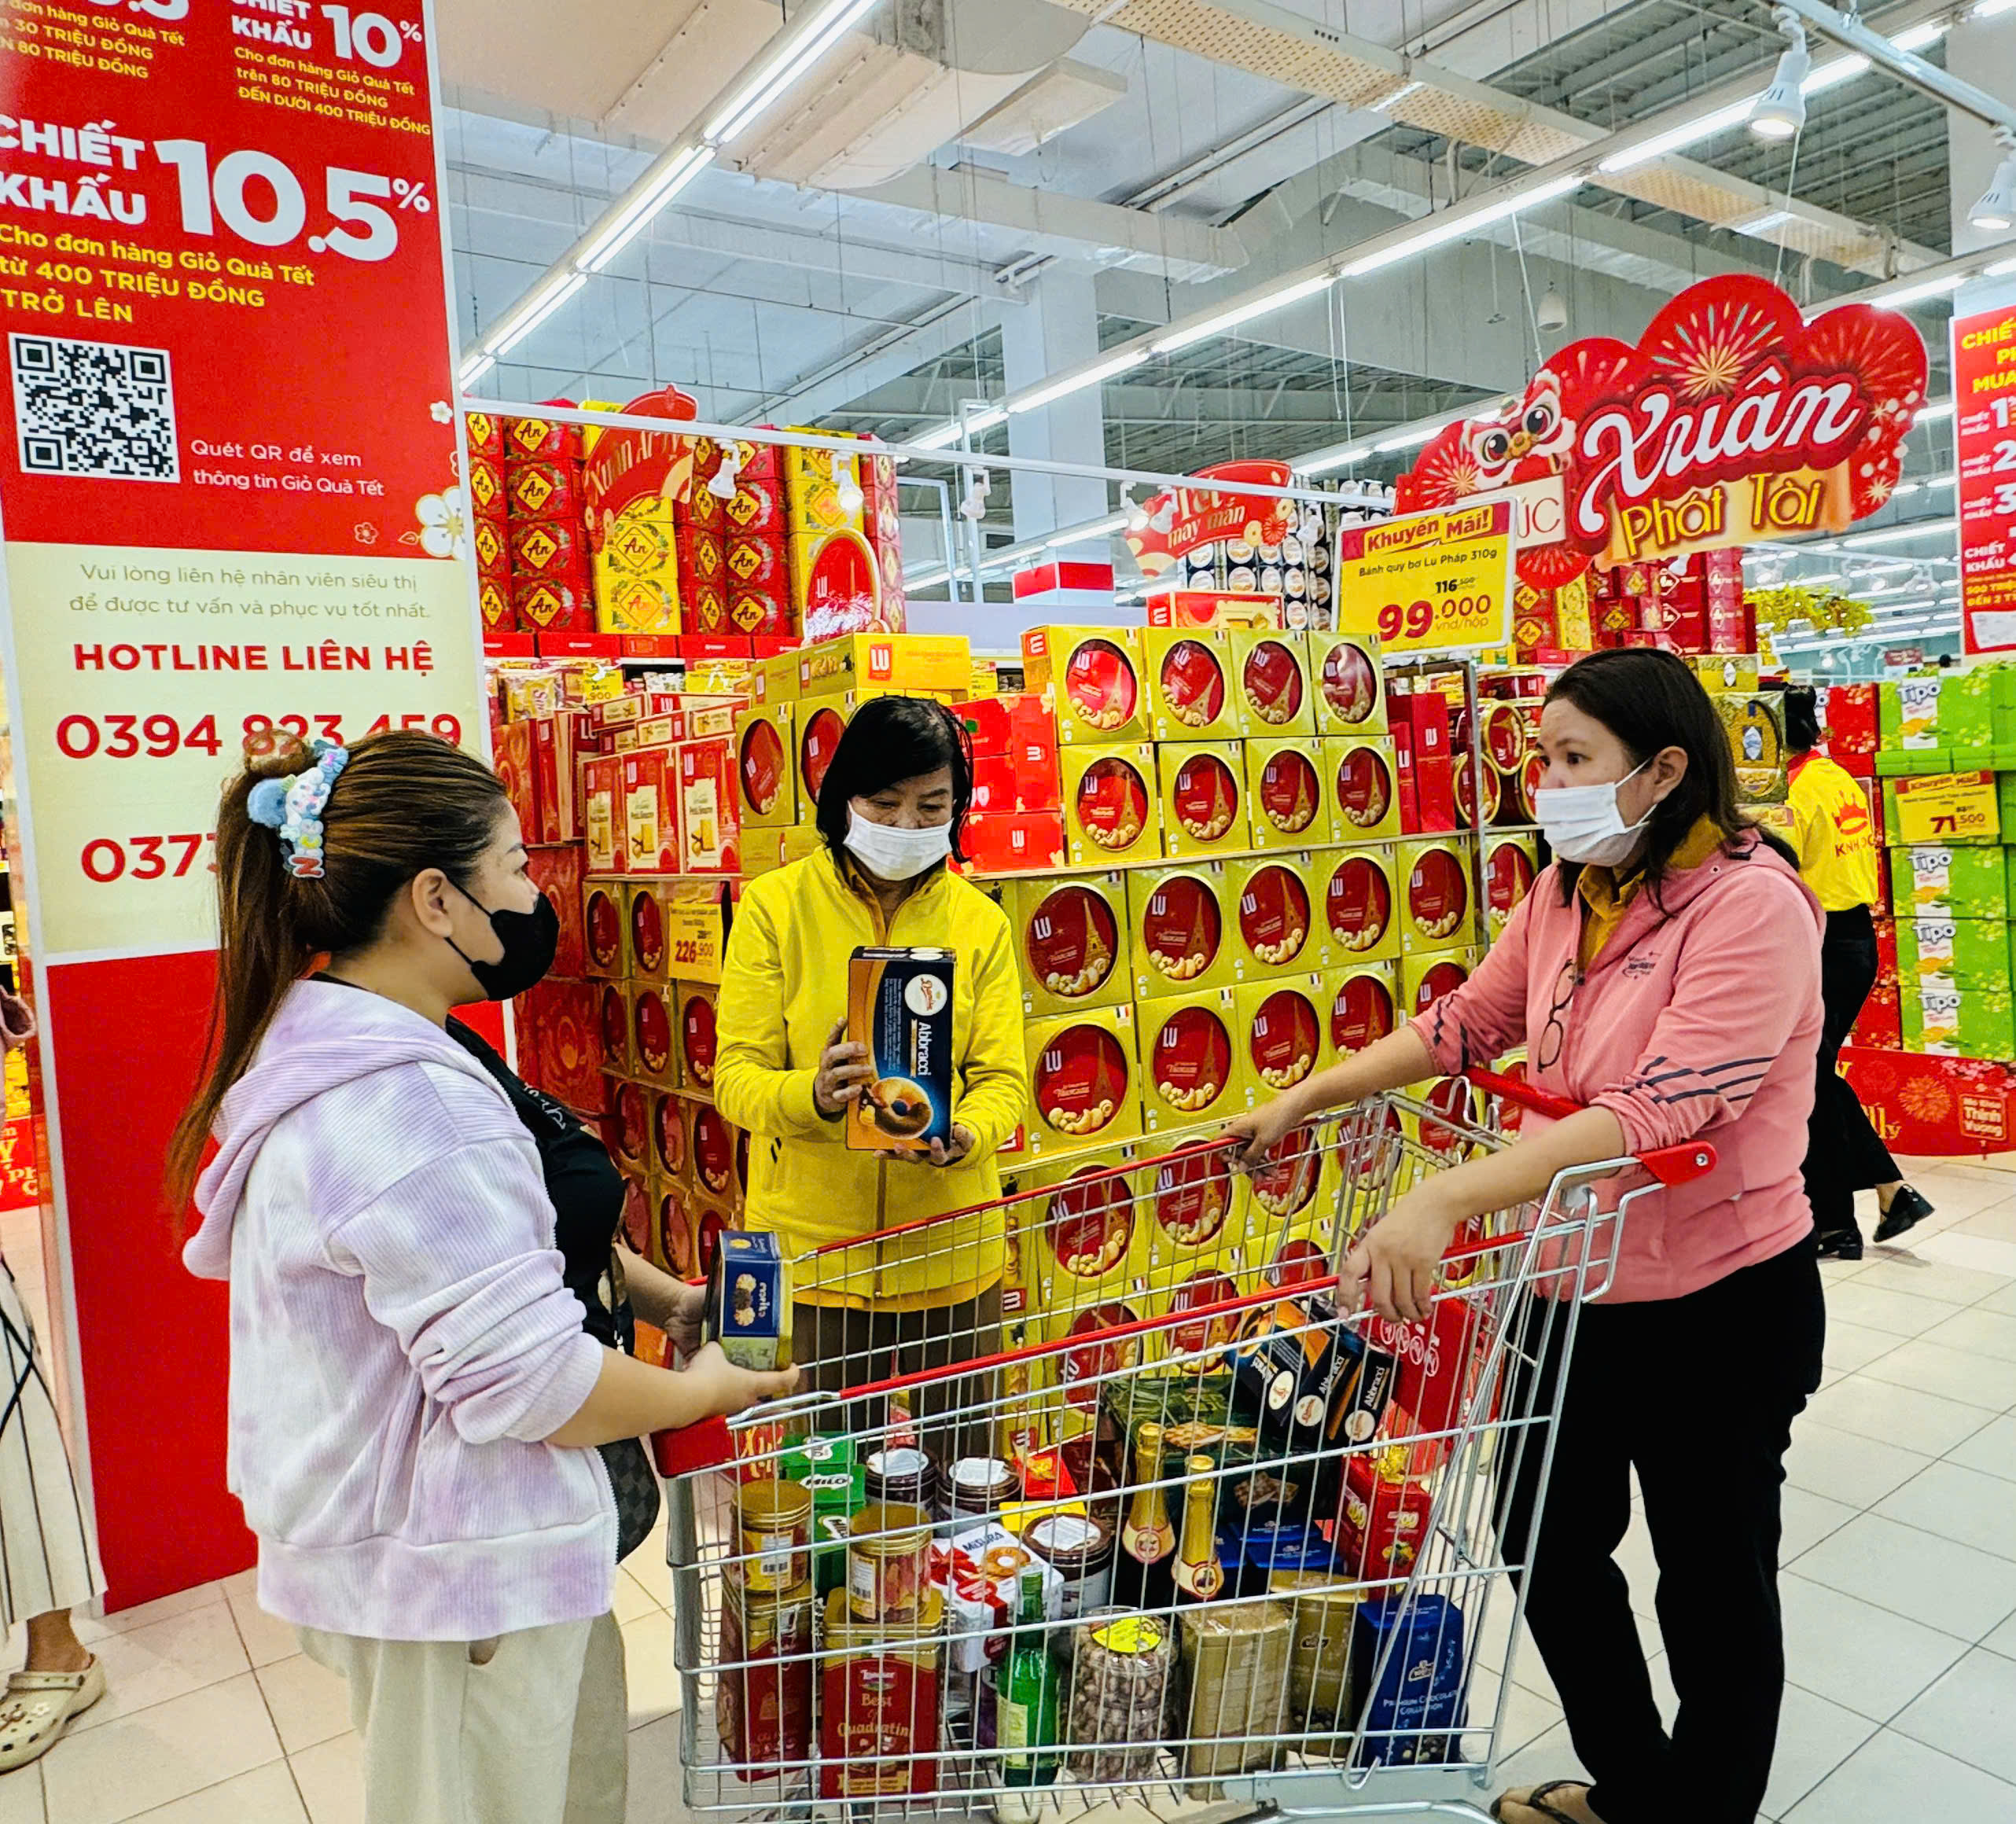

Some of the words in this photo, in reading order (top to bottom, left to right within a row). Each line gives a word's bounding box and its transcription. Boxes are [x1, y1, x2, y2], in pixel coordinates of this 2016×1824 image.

[15, 19, 39, 34] 30
[43, 25, 96, 47] TRIỆU
[47, 5, 88, 27] hàng
[93, 16, 120, 31] Giỏ
[123, 24, 156, 39] Quả
[160, 30, 186, 46] Tết
[231, 14, 312, 50] KHẤU
[18, 41, 40, 56] 80
[44, 46, 94, 68] TRIỆU
[234, 46, 264, 63] Cho
[267, 53, 296, 70] đơn
[298, 61, 333, 79] hàng
[336, 70, 360, 83] Giỏ
[362, 75, 392, 90] Quả
[393, 80, 415, 96] Tết
[237, 67, 268, 83] trên
[271, 74, 292, 88] 80
[295, 78, 340, 100] TRIỆU
[238, 85, 271, 104] ĐẾN
[315, 103, 344, 118] 400
[346, 108, 387, 128] TRIỆU
[0, 172, 147, 226] KHẤU
[0, 223, 49, 248] Cho
[55, 234, 105, 256] đơn
[112, 240, 173, 269] hàng
[180, 251, 221, 272] Giỏ
[227, 258, 274, 280] Quả
[278, 264, 315, 286] Tết
[0, 256, 28, 277] từ
[36, 262, 92, 285] 400
[99, 269, 179, 299] TRIỆU
[187, 278, 265, 308] ĐỒNG
[1, 288, 64, 314] TRỞ
[77, 299, 133, 323] LÊN
[520, 421, 543, 441] An
[191, 439, 243, 459] Quét
[251, 443, 282, 462] QR
[289, 444, 315, 464] để
[321, 452, 362, 468] xem
[1579, 366, 1860, 533] Xuân
[193, 469, 252, 491] thông
[254, 473, 278, 491] tin
[281, 474, 313, 492] Giỏ
[317, 476, 353, 495] Quả
[357, 478, 384, 496] Tết
[524, 480, 547, 500] An
[730, 498, 754, 517] An
[1622, 486, 1725, 557] Phát
[1749, 473, 1821, 526] Tài
[1168, 518, 1201, 549] may
[1368, 516, 1440, 552] Khuyến
[1445, 508, 1489, 539] Mãi!
[527, 539, 550, 558] An
[624, 536, 649, 554] An
[732, 551, 756, 570] An
[1359, 565, 1384, 577] Bánh
[1386, 562, 1406, 574] quy
[1424, 555, 1437, 567] Lu
[1440, 552, 1468, 565] Pháp
[1471, 549, 1498, 561] 310g
[80, 564, 116, 581] Vui
[123, 564, 171, 586] lòng
[178, 565, 214, 584] liên
[221, 568, 245, 588] hệ
[252, 568, 300, 587] nhân
[307, 570, 346, 587] viên
[351, 570, 388, 589] siêu
[393, 573, 418, 591] thị
[69, 592, 98, 612] để
[105, 595, 159, 616] được
[166, 598, 189, 613] tư
[199, 594, 234, 616] vấn
[240, 597, 264, 616] và
[270, 598, 318, 620] phục
[324, 602, 347, 621] vụ
[352, 598, 380, 617] tốt
[531, 597, 554, 616] An
[736, 605, 760, 623] An
[73, 644, 268, 671] HOTLINE
[282, 639, 371, 671] LIÊN
[385, 640, 434, 676] HỆ
[871, 649, 889, 671] LU
[1076, 652, 1090, 670] LU
[1174, 647, 1190, 667] LU
[57, 714, 223, 759] 0394
[1084, 775, 1098, 794] LU
[1179, 773, 1192, 791] LU
[81, 833, 217, 883] 037
[1907, 852, 1952, 873] Tipo
[1331, 877, 1344, 896] LU
[1411, 870, 1423, 888] LU
[1151, 895, 1167, 916] LU
[1242, 892, 1257, 915] LU
[1034, 916, 1052, 940] LU
[1912, 924, 1956, 944] Tipo
[1420, 984, 1432, 1002] LU
[1919, 993, 1961, 1013] Tipo
[1334, 995, 1347, 1016] LU
[1162, 1027, 1178, 1048] LU
[1253, 1016, 1267, 1038] LU
[918, 1022, 933, 1076] Abbracci
[1046, 1050, 1061, 1072] LU
[1159, 1168, 1173, 1190] LU
